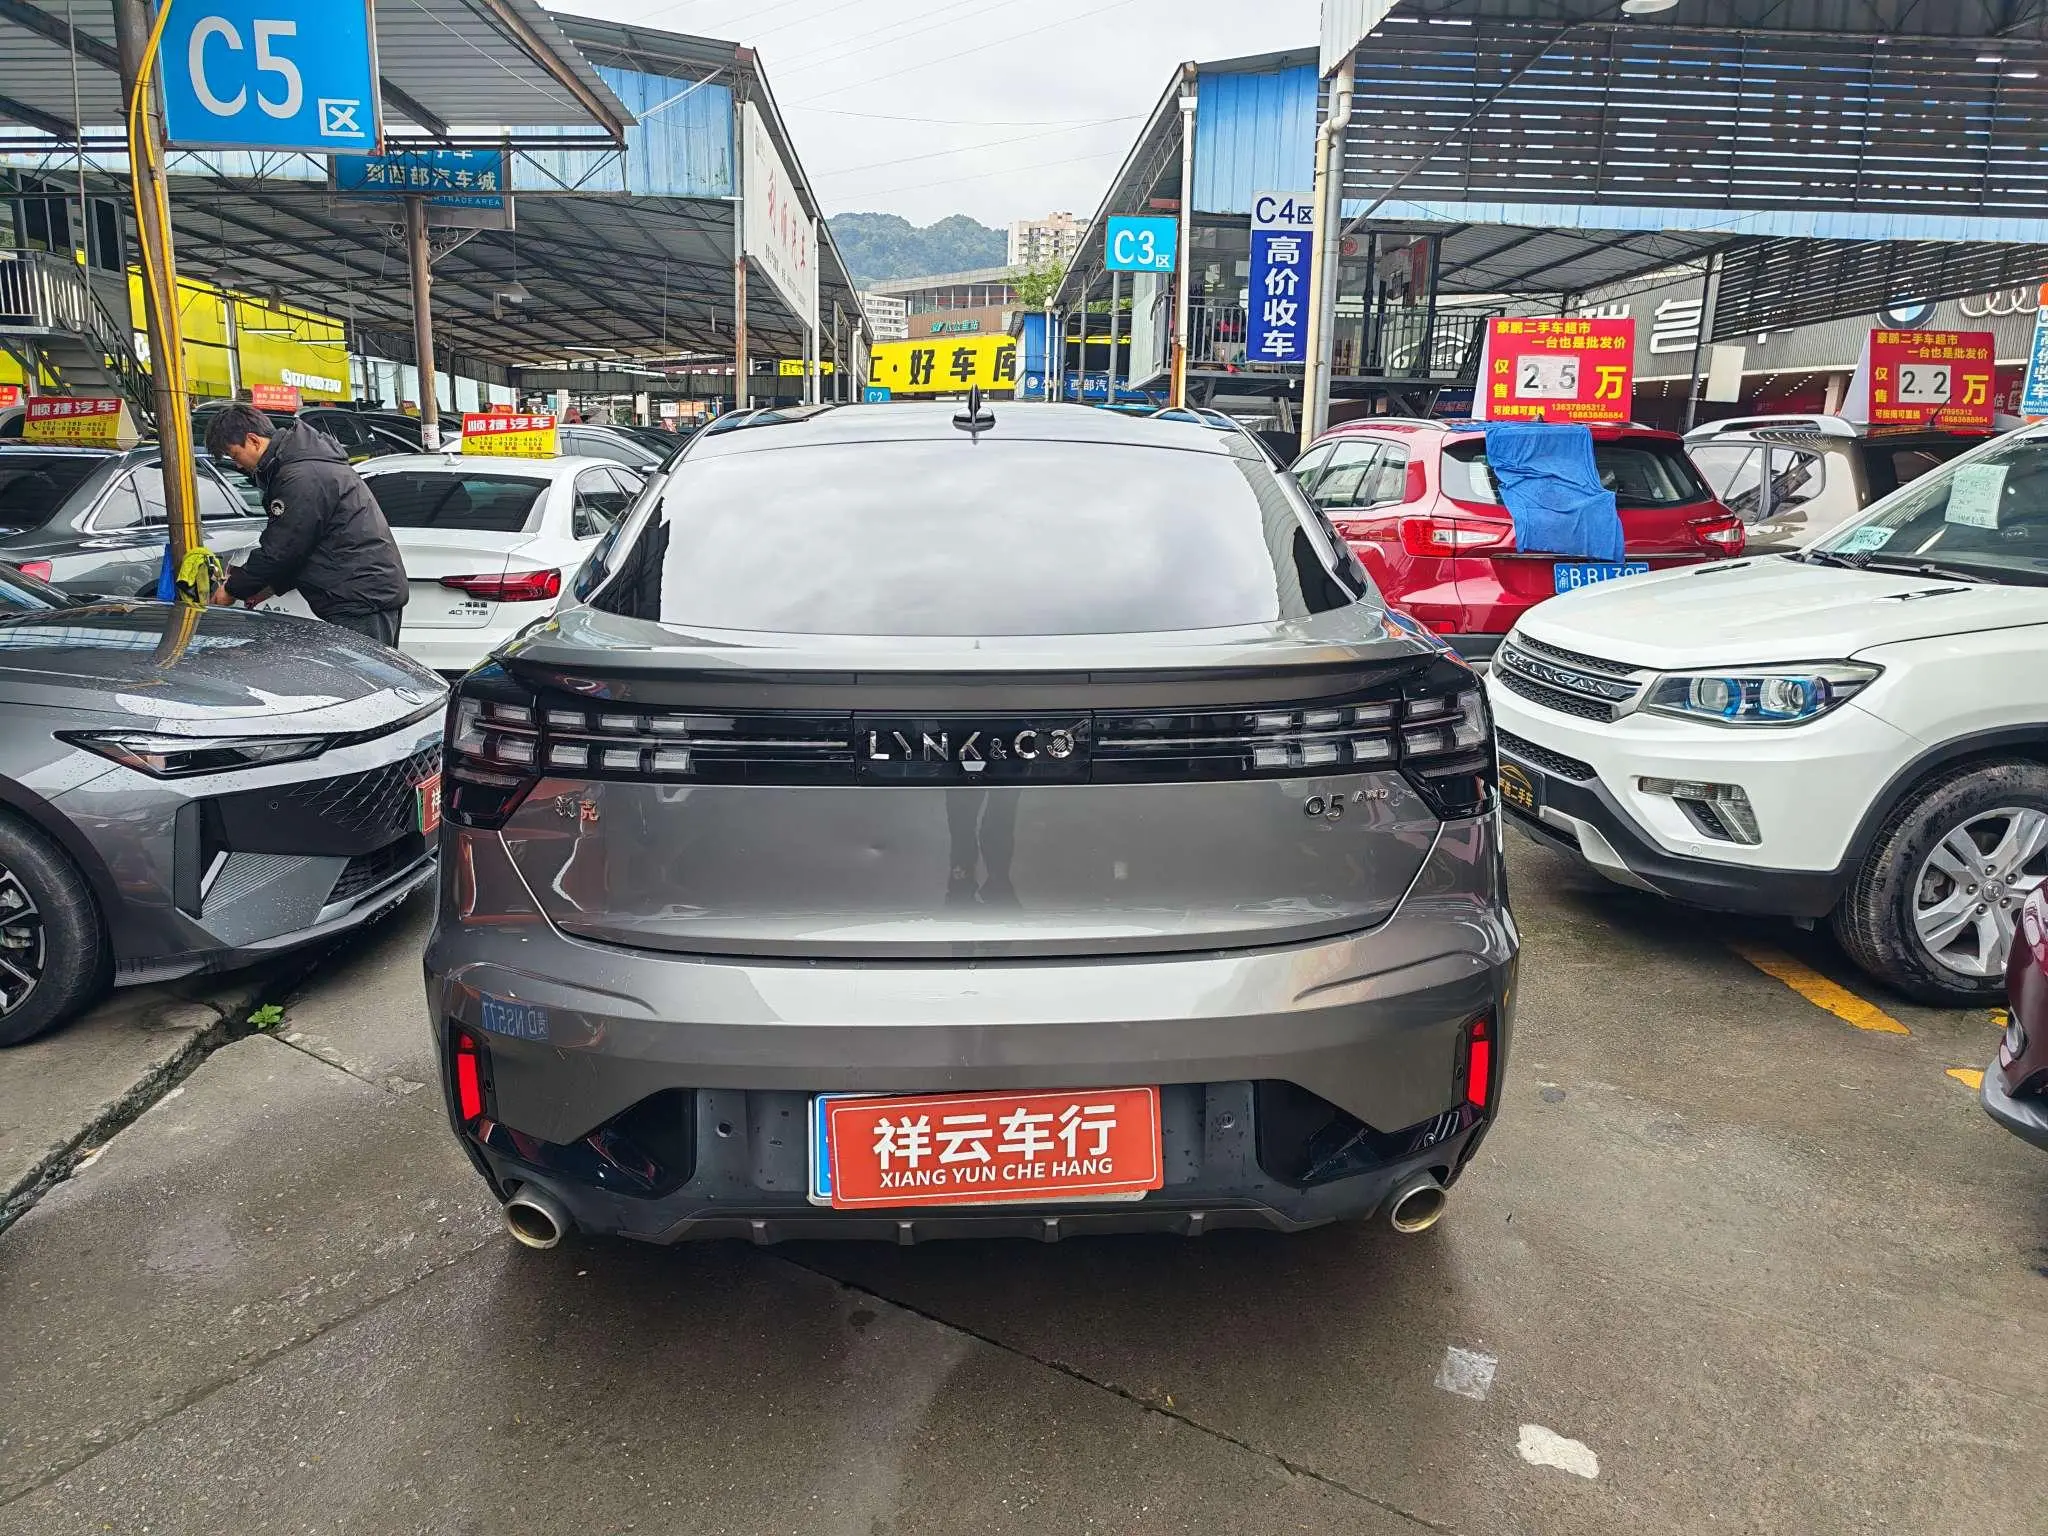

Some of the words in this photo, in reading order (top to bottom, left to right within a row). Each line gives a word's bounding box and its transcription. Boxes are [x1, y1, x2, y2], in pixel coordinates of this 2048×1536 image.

[366, 163, 497, 191] 到西部汽车城
[1262, 236, 1301, 357] 高价收车
[1532, 336, 1627, 349] 一台也是批发价
[1907, 347, 1988, 359] 一台也是批发价
[1493, 359, 1509, 398] 仅售
[1523, 364, 1576, 389] 2.5
[1595, 366, 1627, 399] 万
[1875, 367, 1888, 403] 仅售
[1902, 371, 1947, 394] 2.2
[1962, 374, 1989, 404] 万
[31, 400, 116, 416] 顺捷汽车
[467, 417, 551, 432] 顺捷汽车
[1504, 651, 1610, 696] CHANGAN
[872, 1104, 1117, 1169] 祥云车行
[879, 1170, 947, 1188] XIANG
[951, 1165, 997, 1183] YUN
[1002, 1162, 1046, 1180] CHE
[1051, 1158, 1113, 1176] HANG
